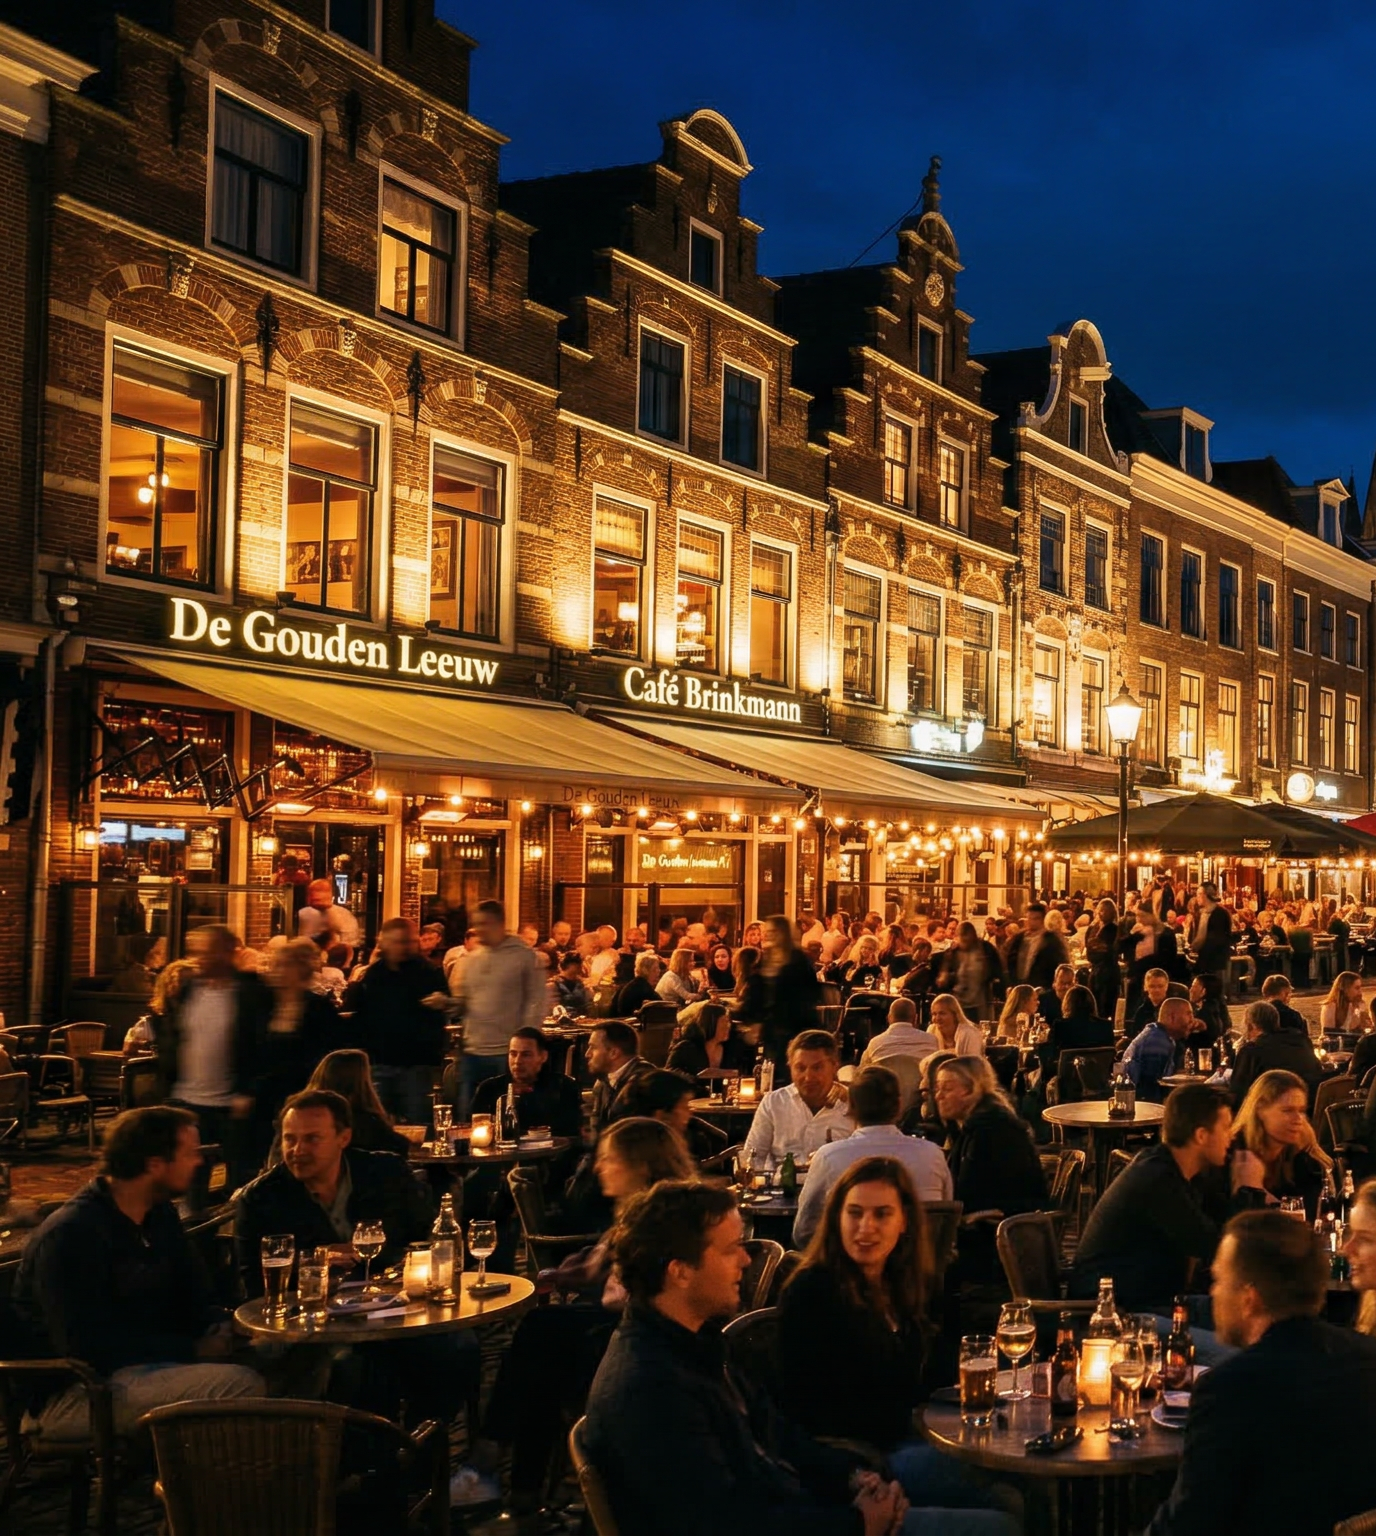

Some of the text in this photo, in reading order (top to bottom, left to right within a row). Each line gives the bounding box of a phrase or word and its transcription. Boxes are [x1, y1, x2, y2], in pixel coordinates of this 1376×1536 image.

[170, 597, 499, 685] De Gouden Leeuw
[624, 666, 802, 723] Café Brinkmann
[562, 786, 582, 802] De
